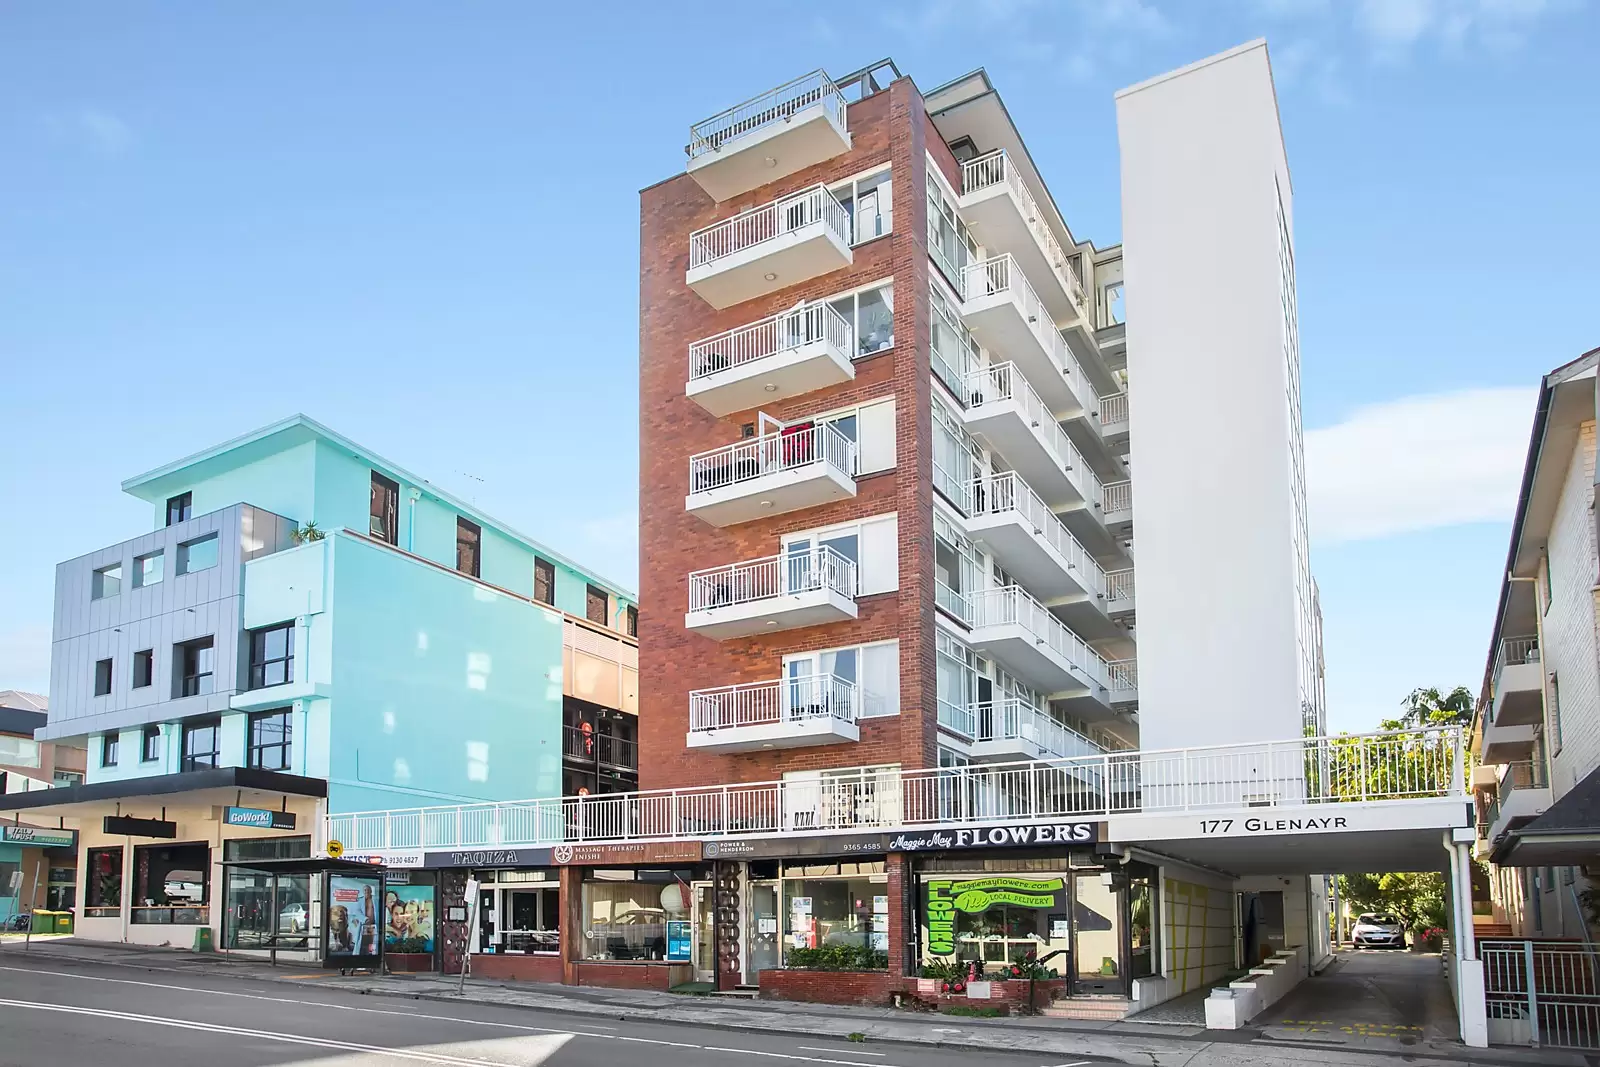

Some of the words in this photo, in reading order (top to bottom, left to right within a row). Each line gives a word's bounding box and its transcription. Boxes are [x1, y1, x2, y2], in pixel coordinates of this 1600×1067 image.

[231, 812, 270, 823] GoWork!
[1200, 819, 1234, 834] 177
[1244, 817, 1348, 832] GLENAYR
[889, 834, 926, 851] Maggie
[927, 831, 952, 848] May
[955, 823, 1092, 847] FLOWERS
[607, 844, 645, 852] THERAPIES
[843, 843, 861, 851] 9365
[863, 842, 881, 850] 4585
[389, 856, 403, 864] 9130
[451, 850, 519, 866] TAQIZA
[575, 853, 601, 861] ENISHI
[956, 878, 1050, 891] maggiemayflowers.com
[989, 892, 1012, 902] LOCAL
[1013, 895, 1050, 905] DELIVERY
[927, 880, 956, 956] FLOWERS
